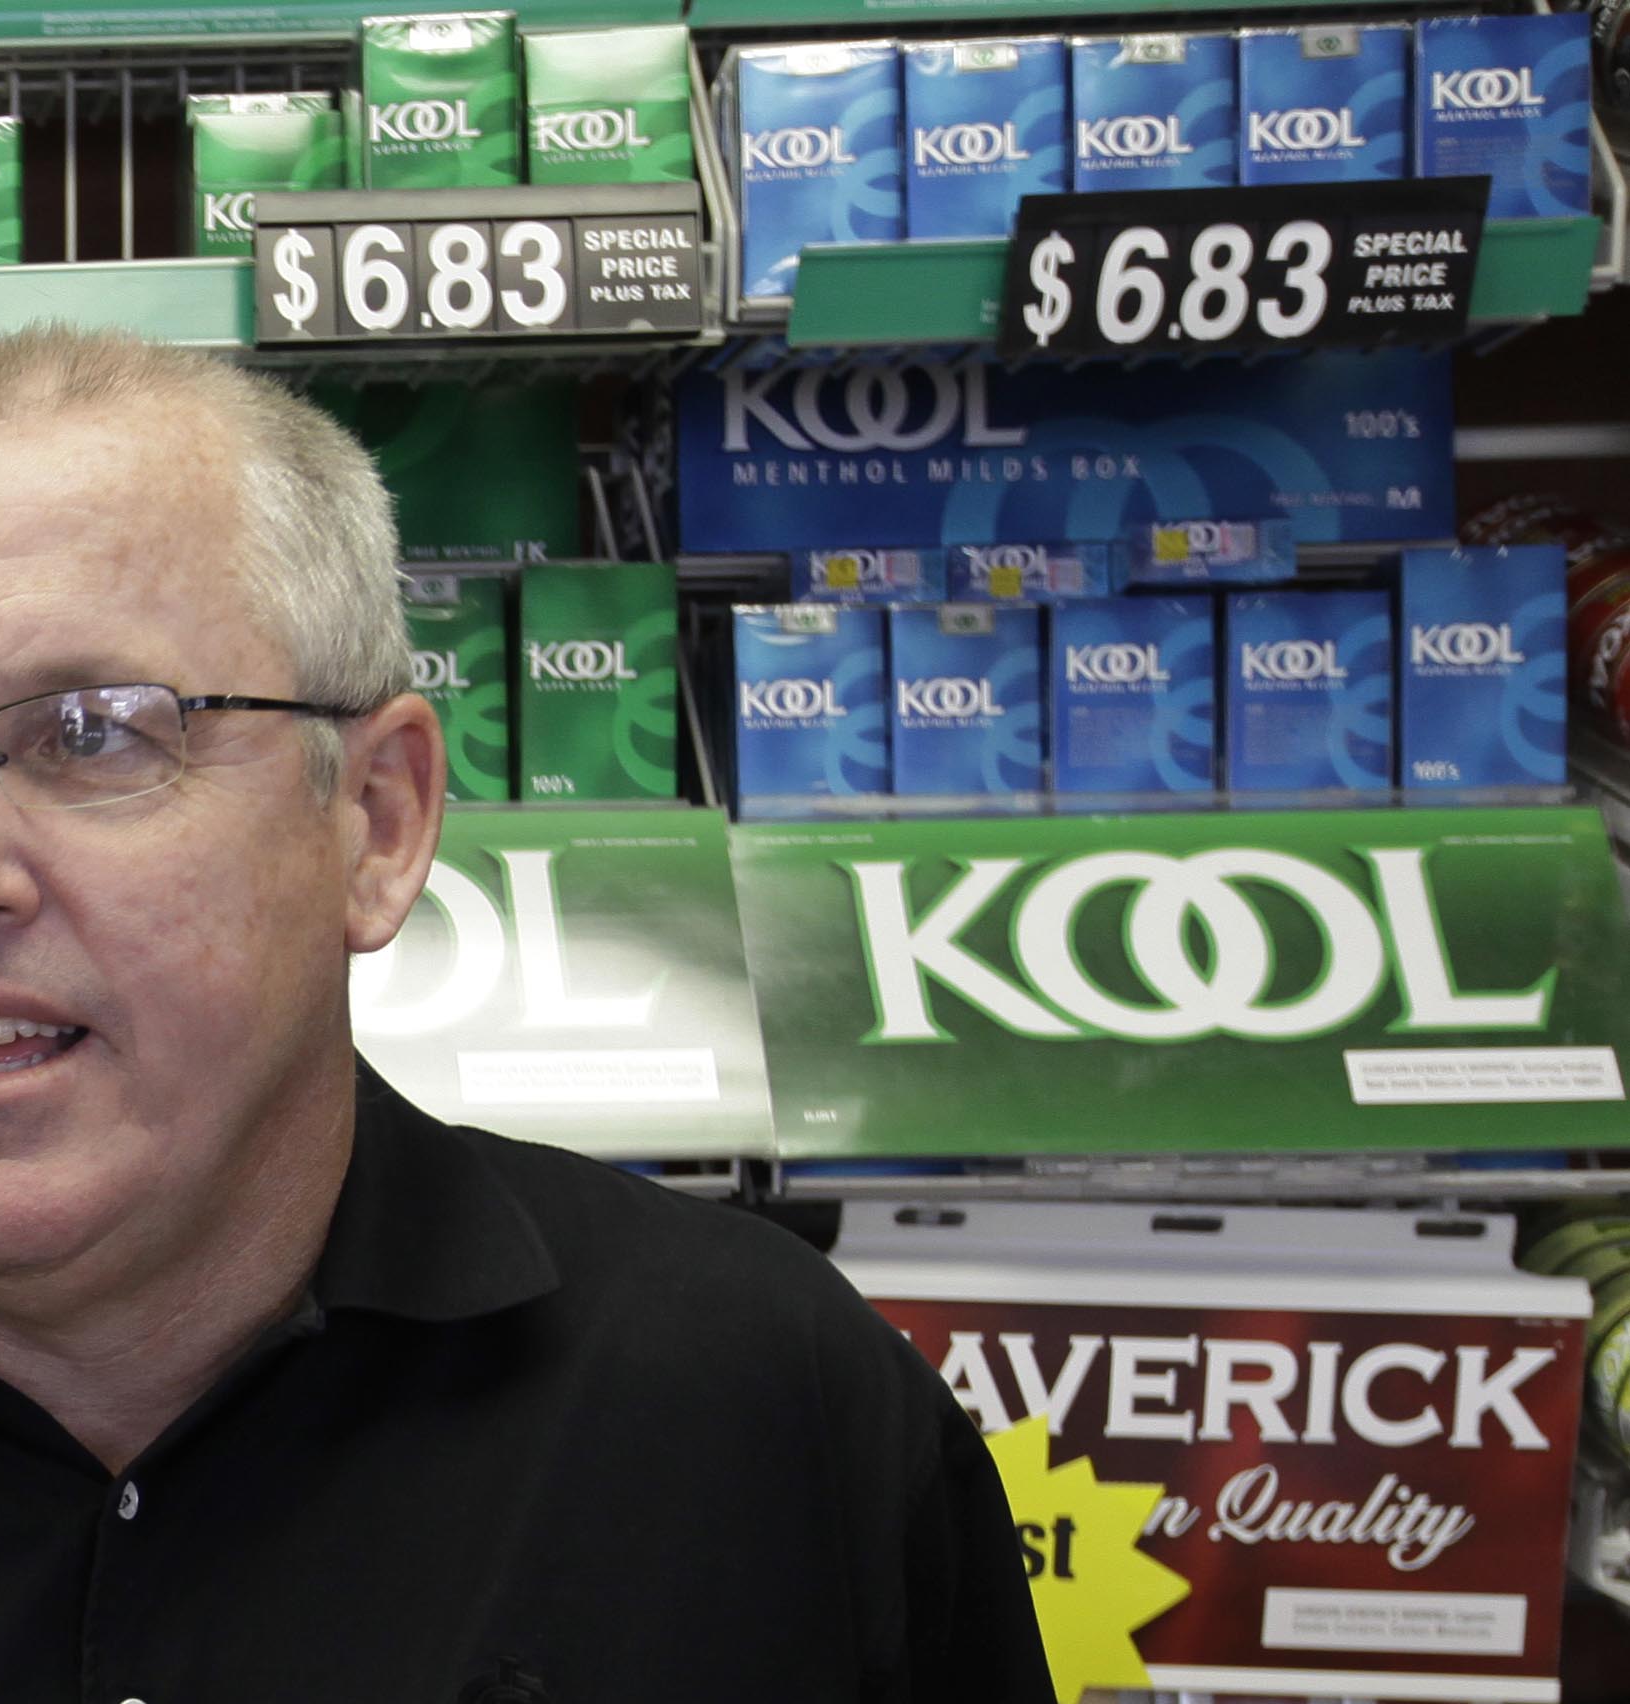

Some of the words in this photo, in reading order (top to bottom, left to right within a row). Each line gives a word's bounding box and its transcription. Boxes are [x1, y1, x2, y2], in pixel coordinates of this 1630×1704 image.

[1432, 69, 1544, 109] KOOL
[537, 109, 651, 151] KOOL
[914, 123, 1029, 165] KOOL
[1249, 108, 1365, 152] KOOL
[584, 229, 692, 252] SPECIAL
[1353, 230, 1469, 256] SPECIAL
[272, 222, 568, 330] $6.83
[602, 256, 678, 280] PRICE
[1021, 220, 1333, 345] $6.83
[1366, 262, 1447, 288] PRICE
[590, 284, 645, 303] PLUS
[650, 283, 691, 302] TAX
[1347, 295, 1397, 313] PLUS
[1402, 293, 1455, 312] TAX
[721, 359, 1028, 453] KOOL
[733, 461, 907, 485] MENTHOL
[928, 458, 1050, 482] MILDS
[1073, 456, 1142, 480] BOX
[1066, 645, 1170, 682] KOOL
[1411, 623, 1524, 666] KOOL
[741, 681, 846, 717] KOOL
[834, 843, 1557, 1044] KOOL
[904, 1332, 1560, 1450] AVERICK
[1208, 1464, 1474, 1571] Quality
